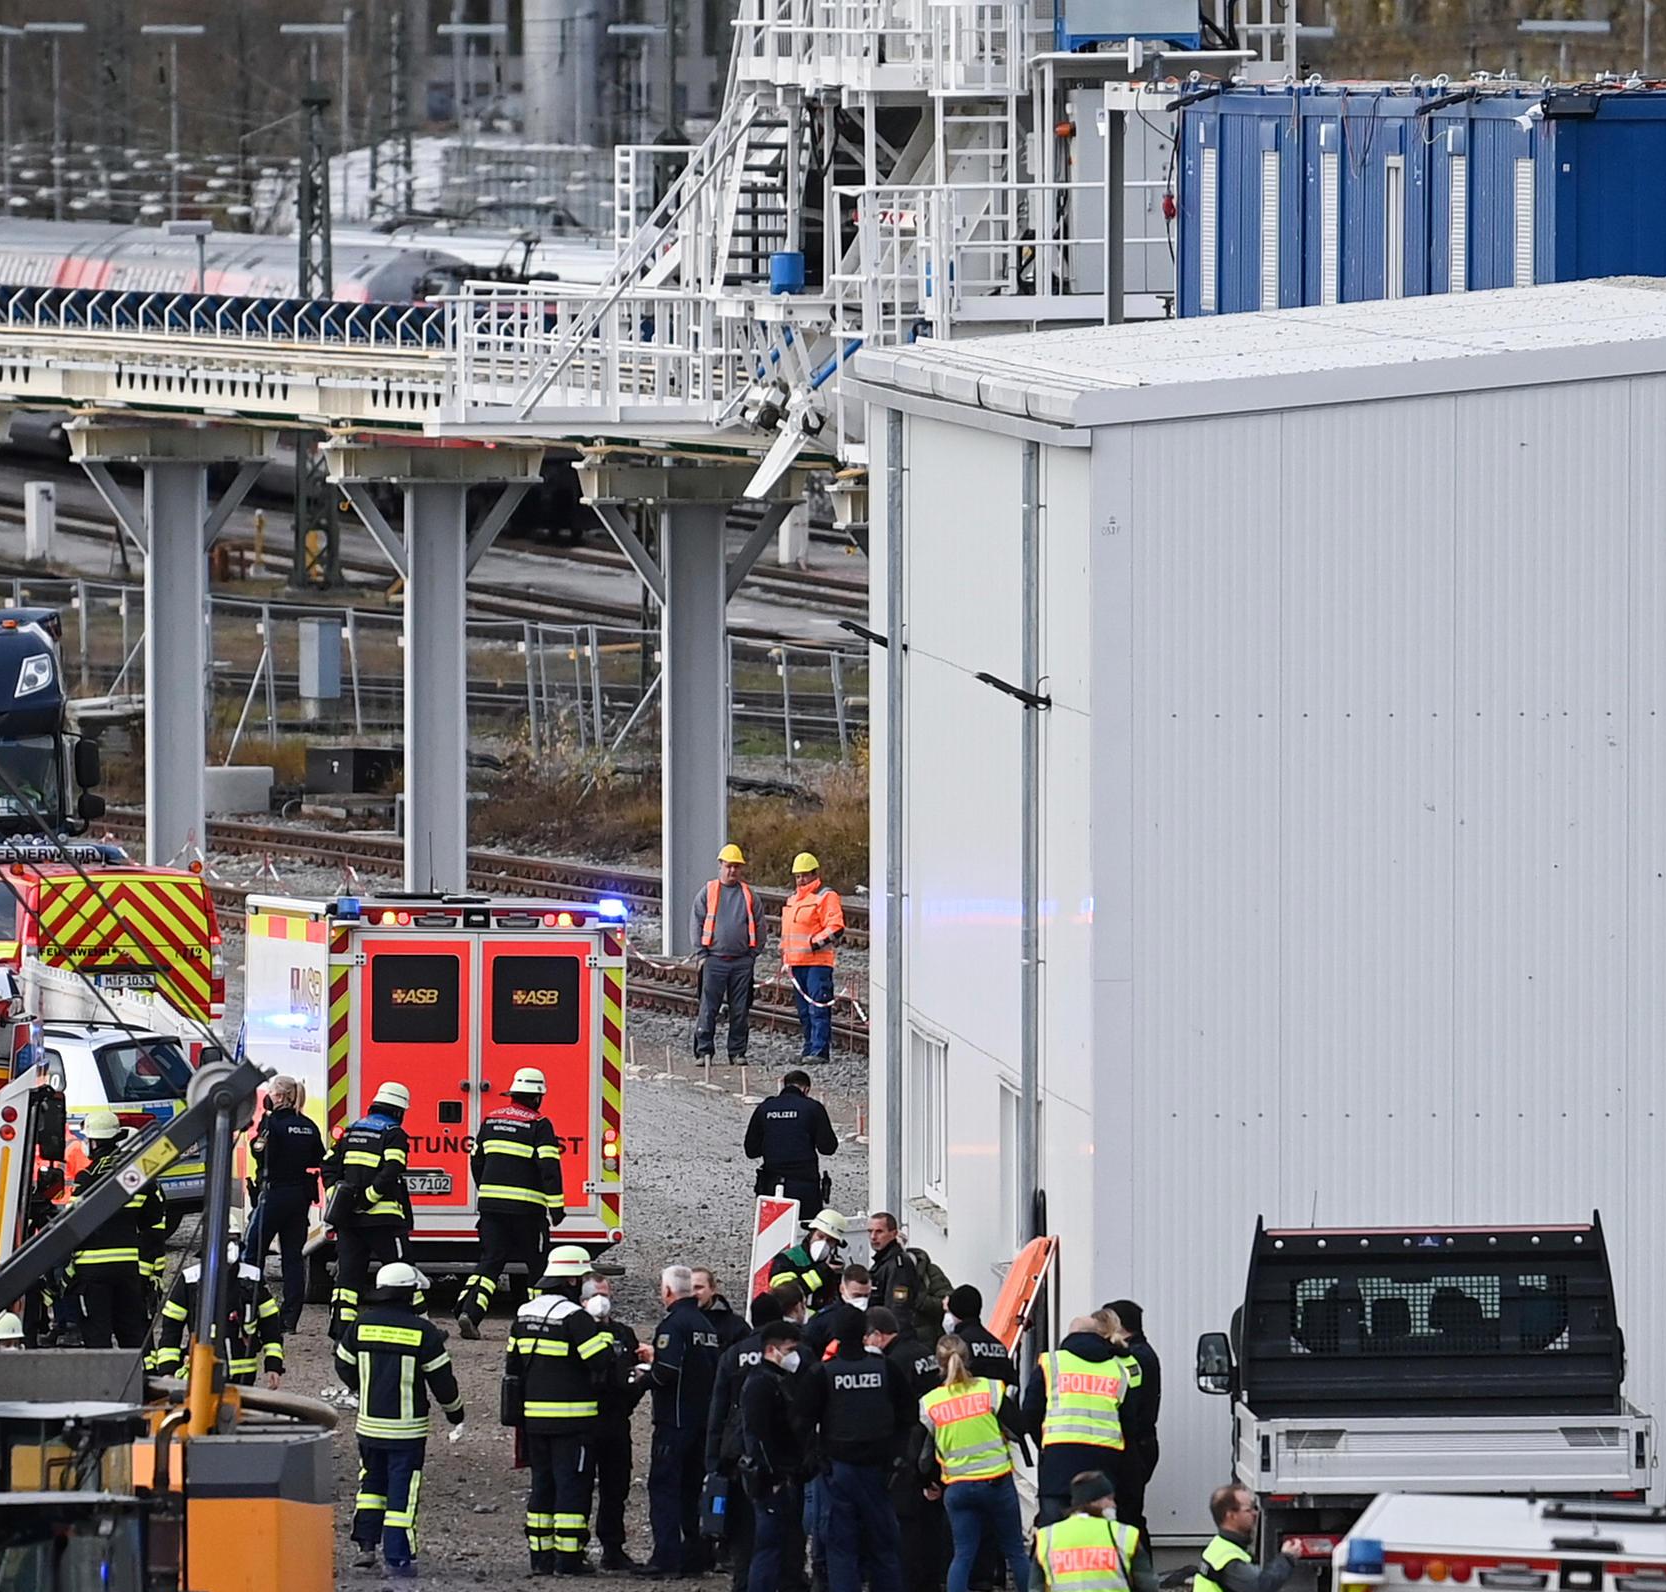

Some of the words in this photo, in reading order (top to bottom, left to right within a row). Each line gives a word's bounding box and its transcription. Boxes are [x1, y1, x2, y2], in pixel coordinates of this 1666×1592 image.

[403, 988, 440, 1004] ASB
[524, 989, 560, 1005] ASB
[766, 1110, 799, 1119] POLIZEI
[419, 1178, 450, 1190] 7102
[834, 1373, 882, 1390] POLIZEI
[1060, 1373, 1120, 1398] POLIZEI
[928, 1394, 990, 1420] POLIZEI
[1053, 1550, 1117, 1573] POLIZEI
